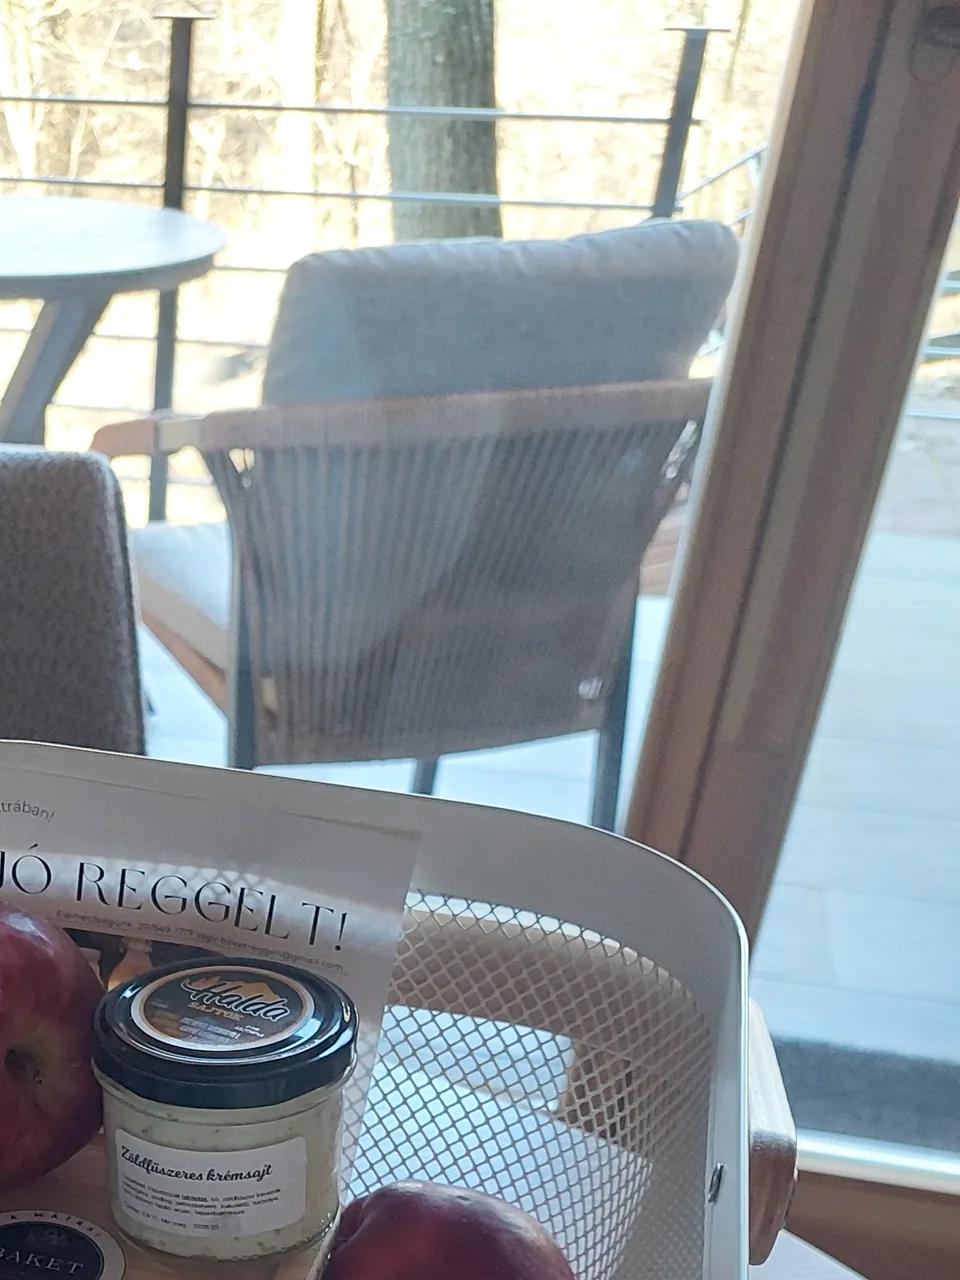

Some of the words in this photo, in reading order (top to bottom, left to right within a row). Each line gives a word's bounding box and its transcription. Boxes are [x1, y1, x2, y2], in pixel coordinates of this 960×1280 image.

[74, 861, 349, 951] REGGELT!
[180, 978, 291, 1022] Halda
[121, 1145, 204, 1181] Zöldfűszeres
[206, 1164, 273, 1182] krémsajt
